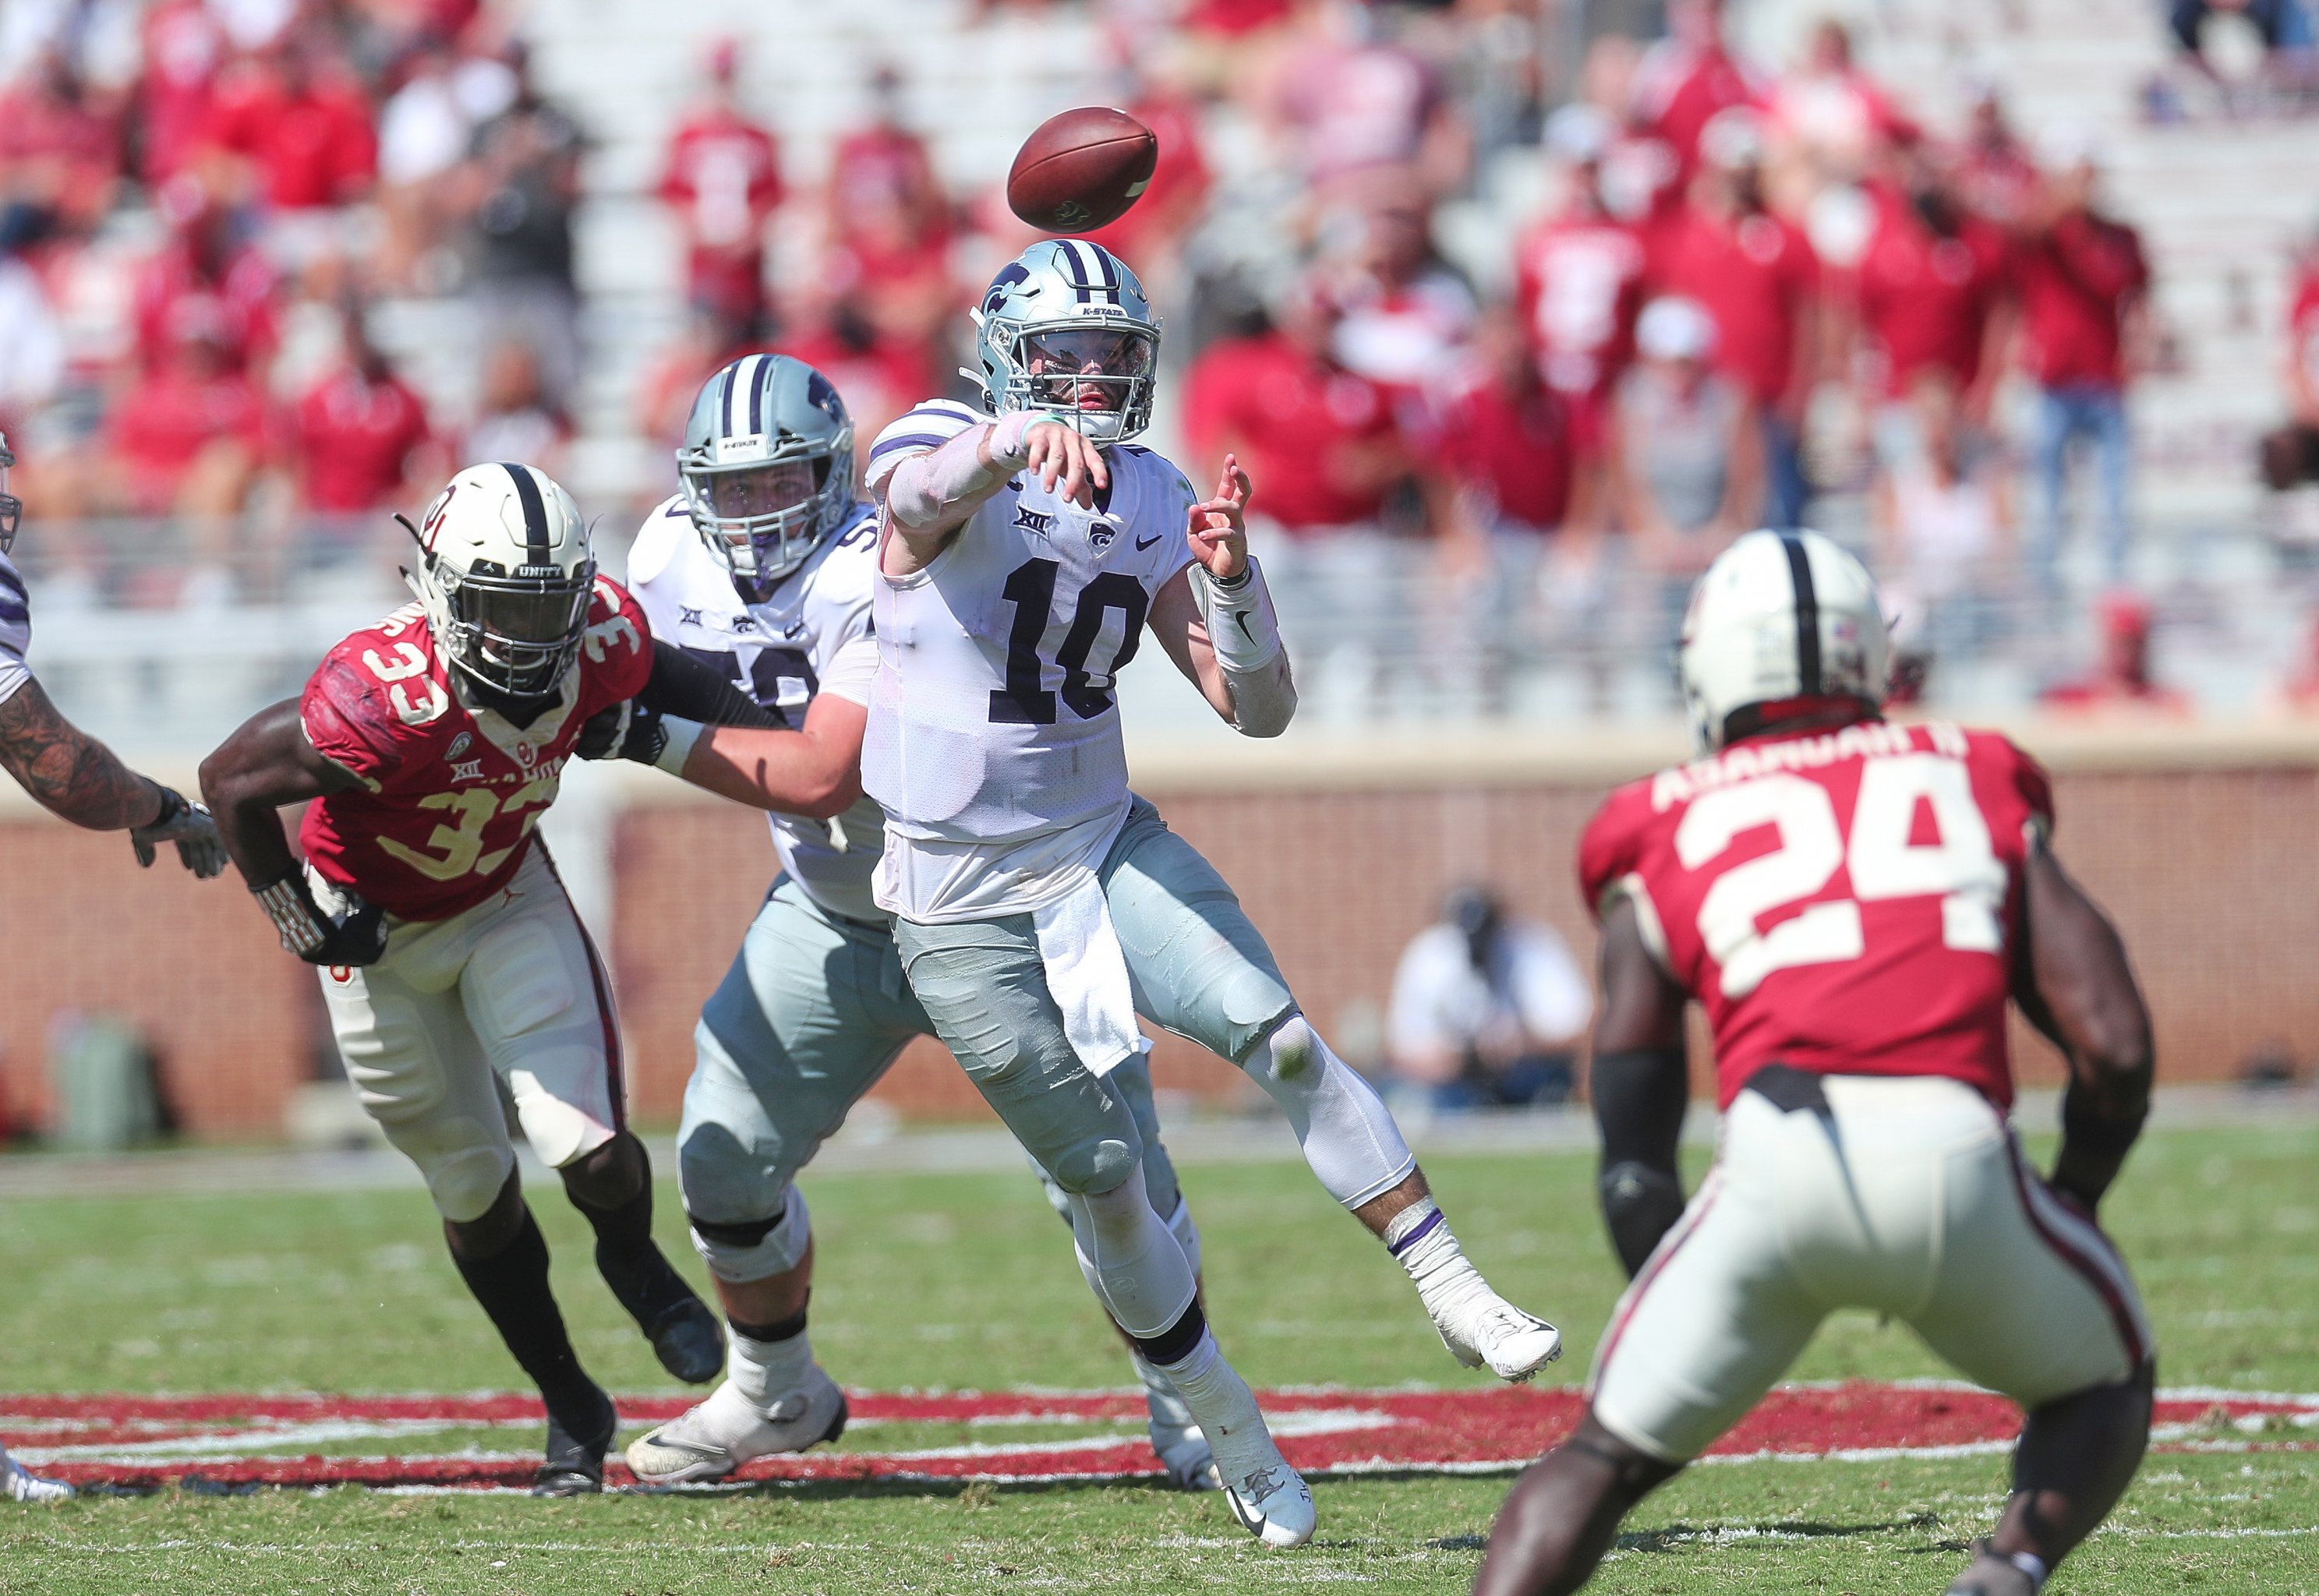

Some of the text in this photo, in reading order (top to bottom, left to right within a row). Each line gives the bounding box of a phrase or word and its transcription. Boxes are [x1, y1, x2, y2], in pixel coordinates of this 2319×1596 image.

[1083, 307, 1125, 316] K-STATE
[518, 566, 561, 577] UNITY
[988, 556, 1150, 725] 10
[362, 641, 449, 726] 33
[450, 758, 485, 784] XII
[1674, 751, 2008, 999] 24
